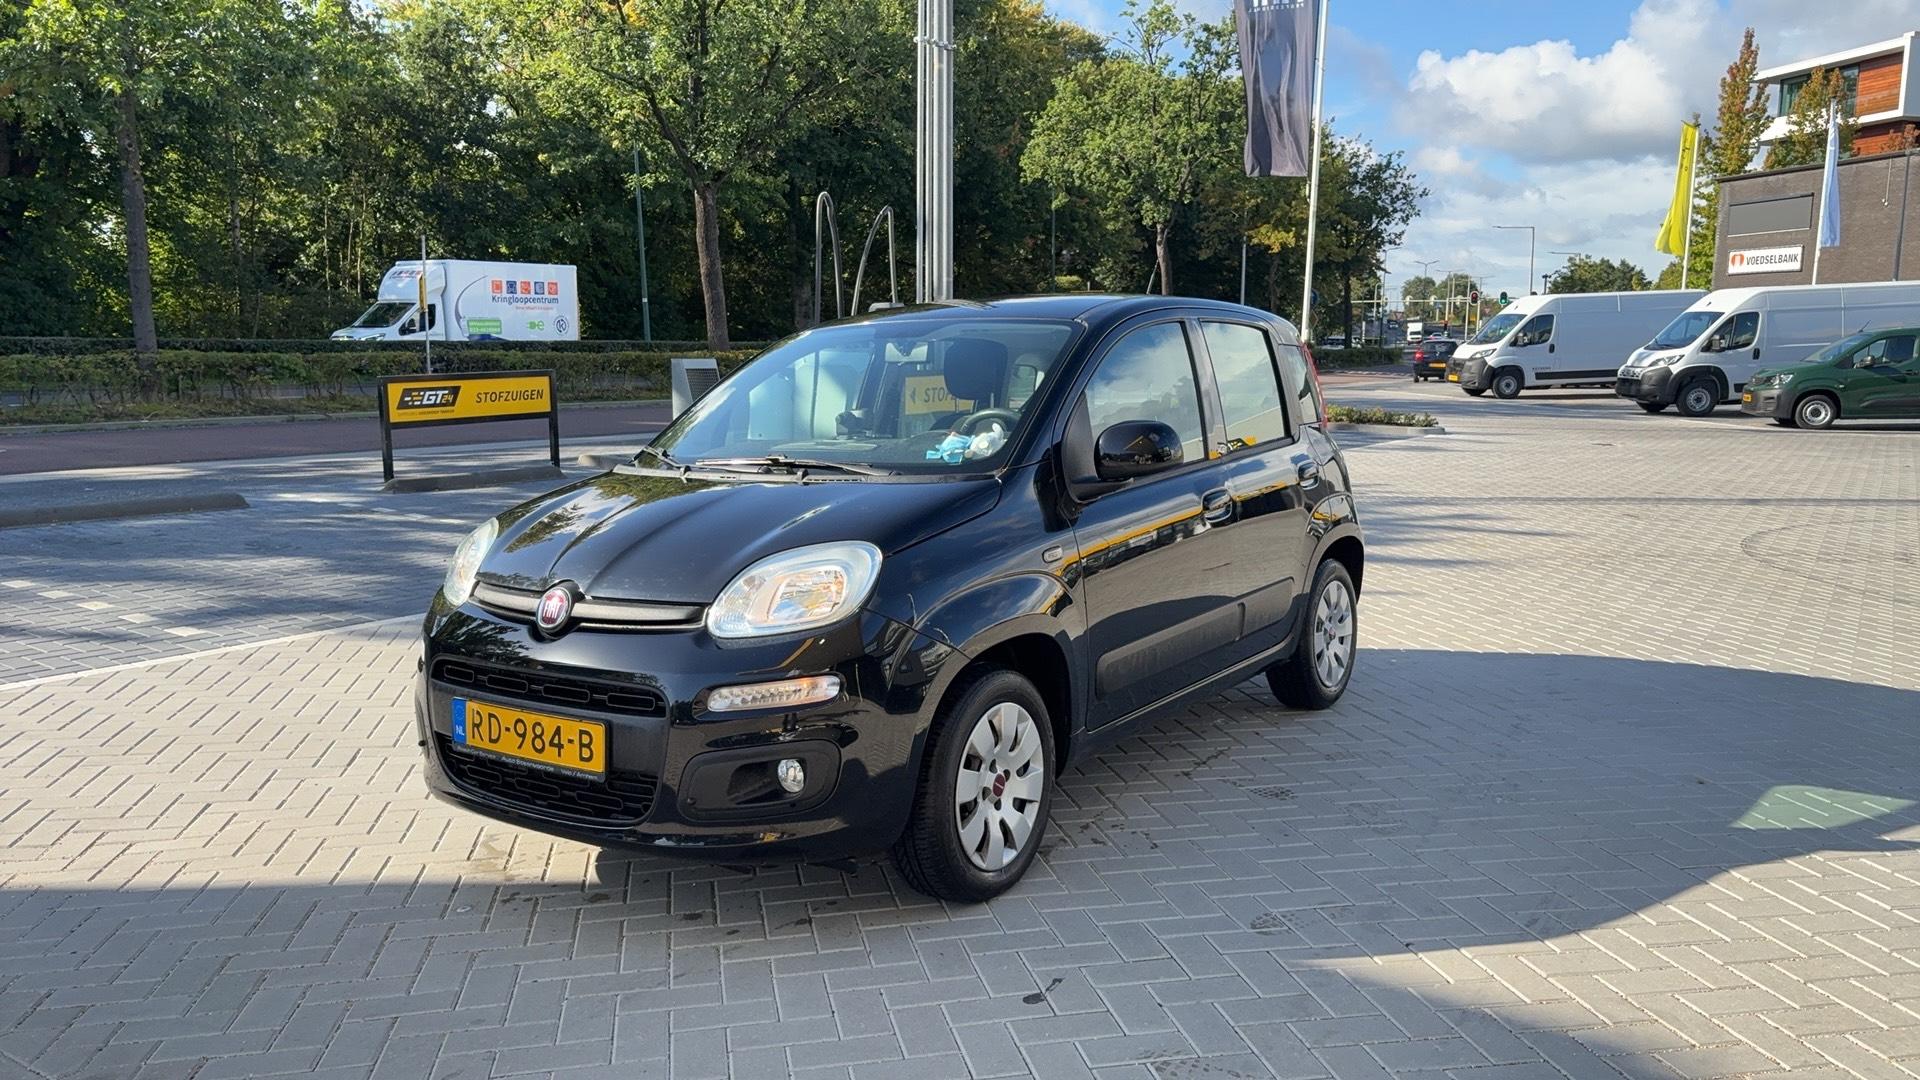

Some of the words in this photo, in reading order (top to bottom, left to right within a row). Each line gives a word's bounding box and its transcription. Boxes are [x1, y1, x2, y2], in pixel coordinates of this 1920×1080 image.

[1746, 253, 1799, 266] VOEDSELBANK
[492, 295, 559, 305] Kringloopcentrum
[422, 390, 454, 405] GT24
[475, 388, 544, 404] STOFZUIGEN
[455, 724, 465, 736] NL
[471, 708, 594, 763] RD-984-B
